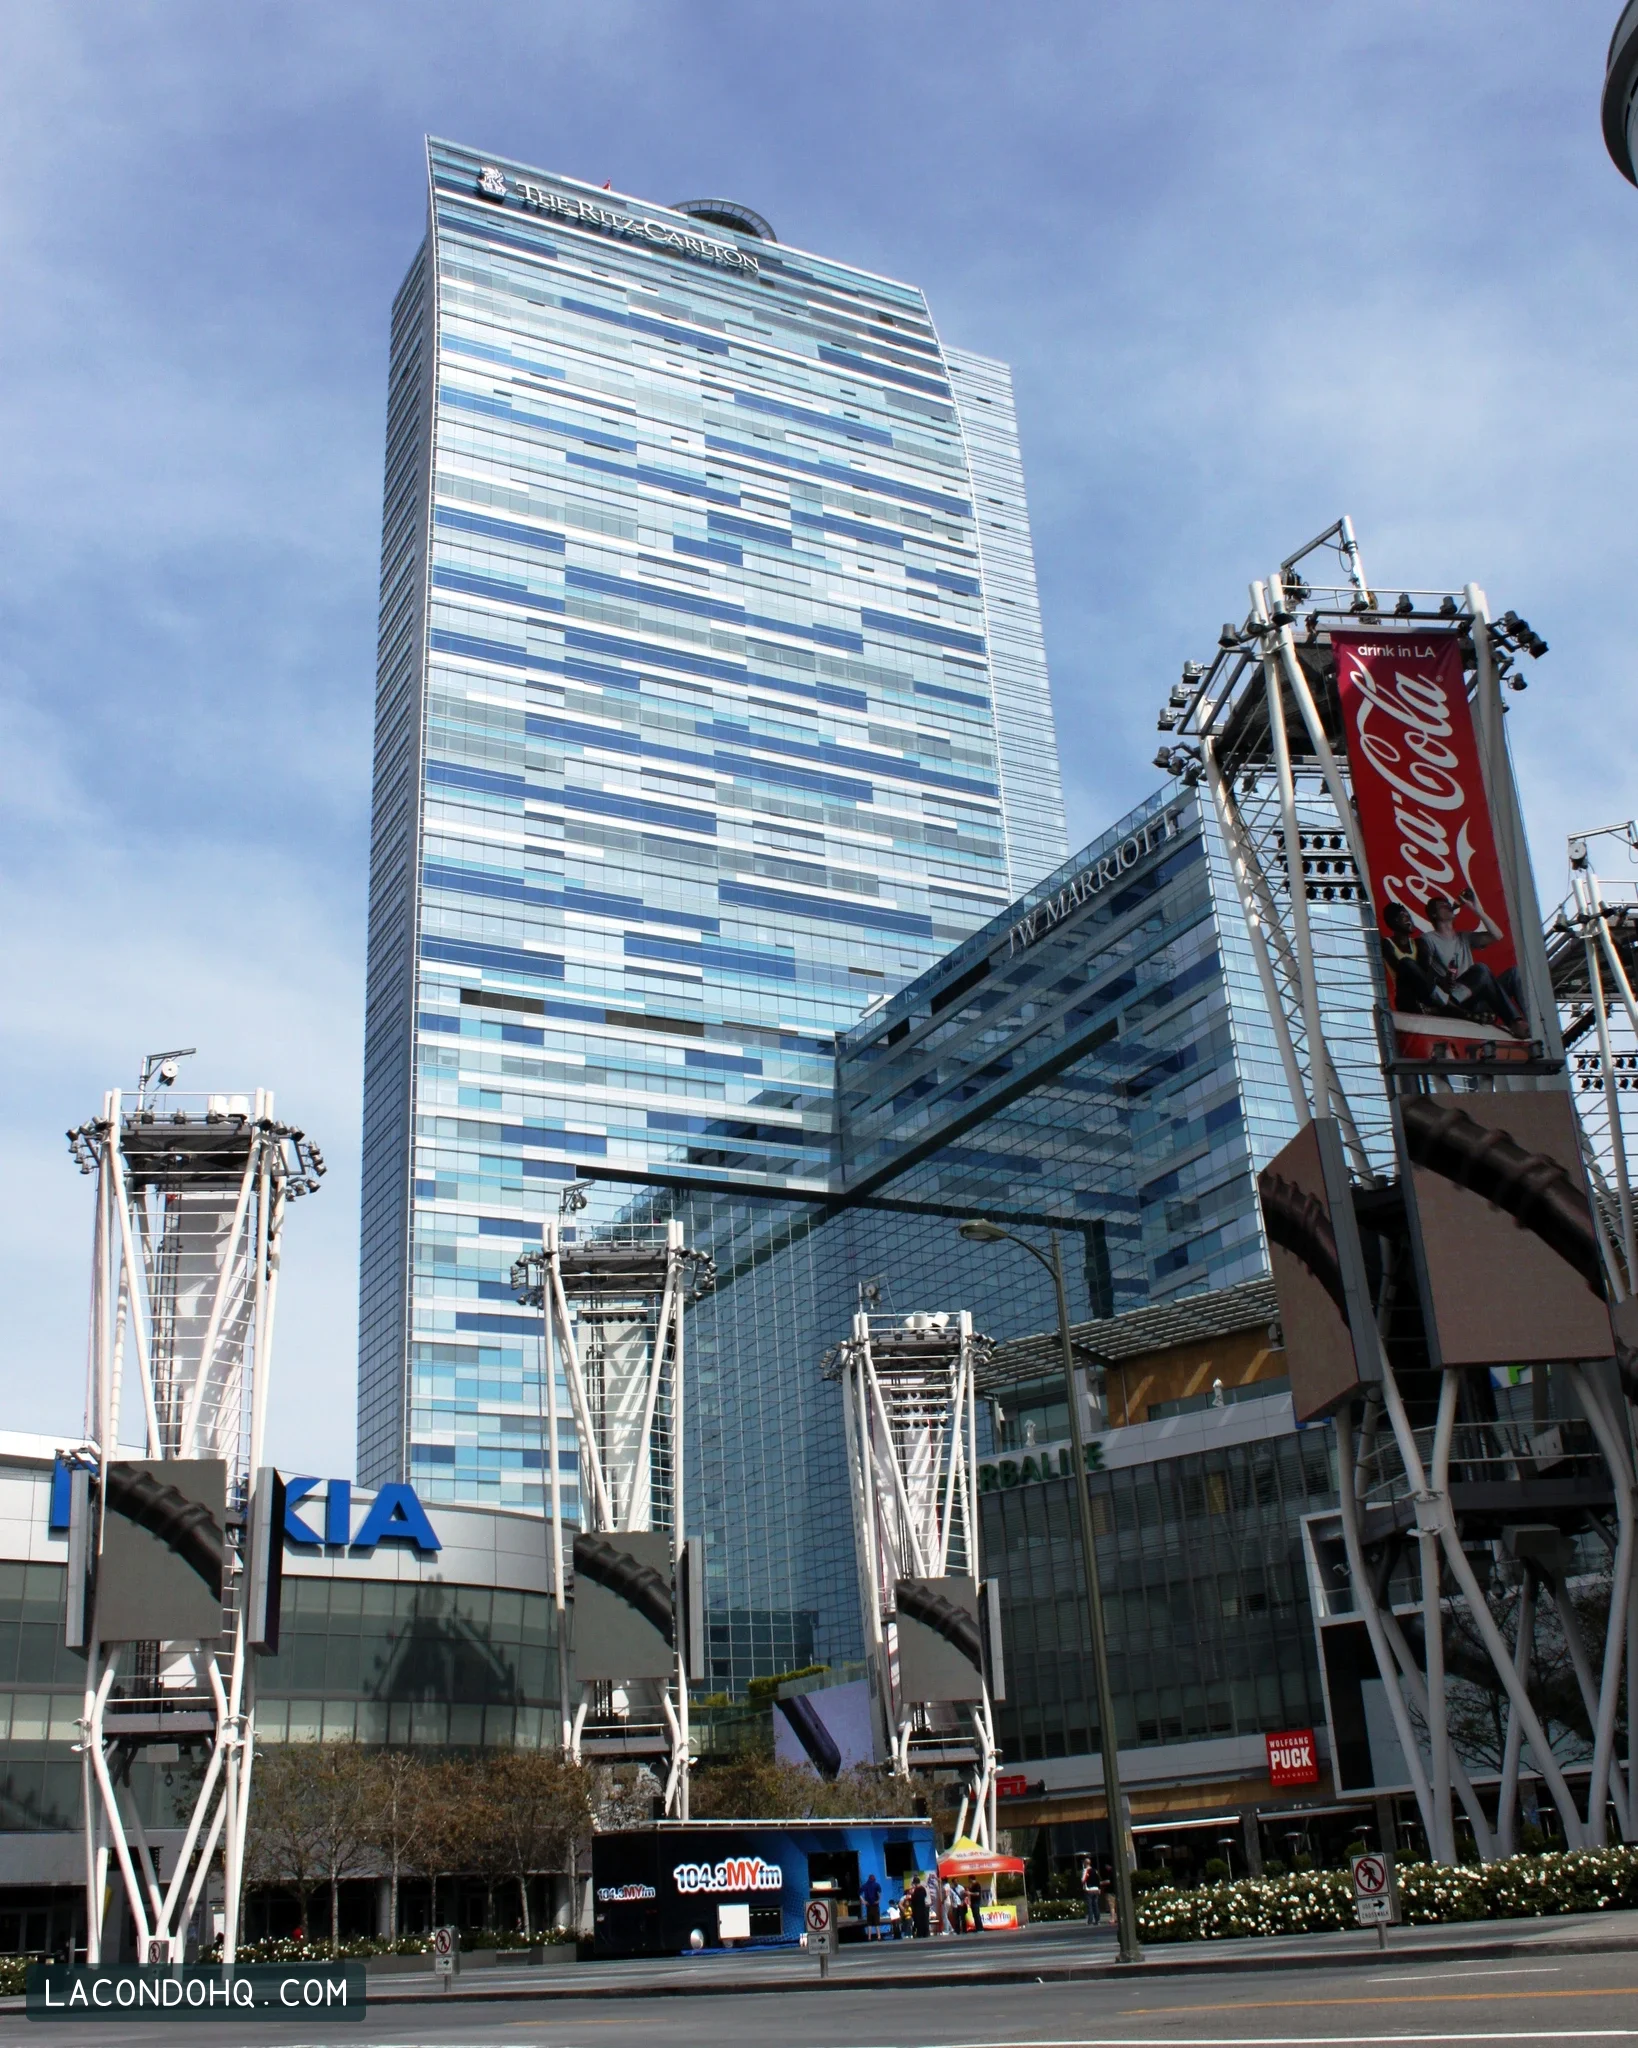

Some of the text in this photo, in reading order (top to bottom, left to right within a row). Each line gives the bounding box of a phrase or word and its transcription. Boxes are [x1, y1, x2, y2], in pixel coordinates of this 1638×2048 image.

[516, 182, 760, 274] THE RITZ-CARLTON
[1357, 643, 1436, 658] drink in LA
[1009, 804, 1184, 959] JW MARRIOTT
[1268, 1736, 1309, 1748] WOLFGANG
[1270, 1746, 1313, 1770] PUCK
[675, 1858, 781, 1891] 104.3MYfm
[597, 1884, 656, 1901] 104.3MYfm
